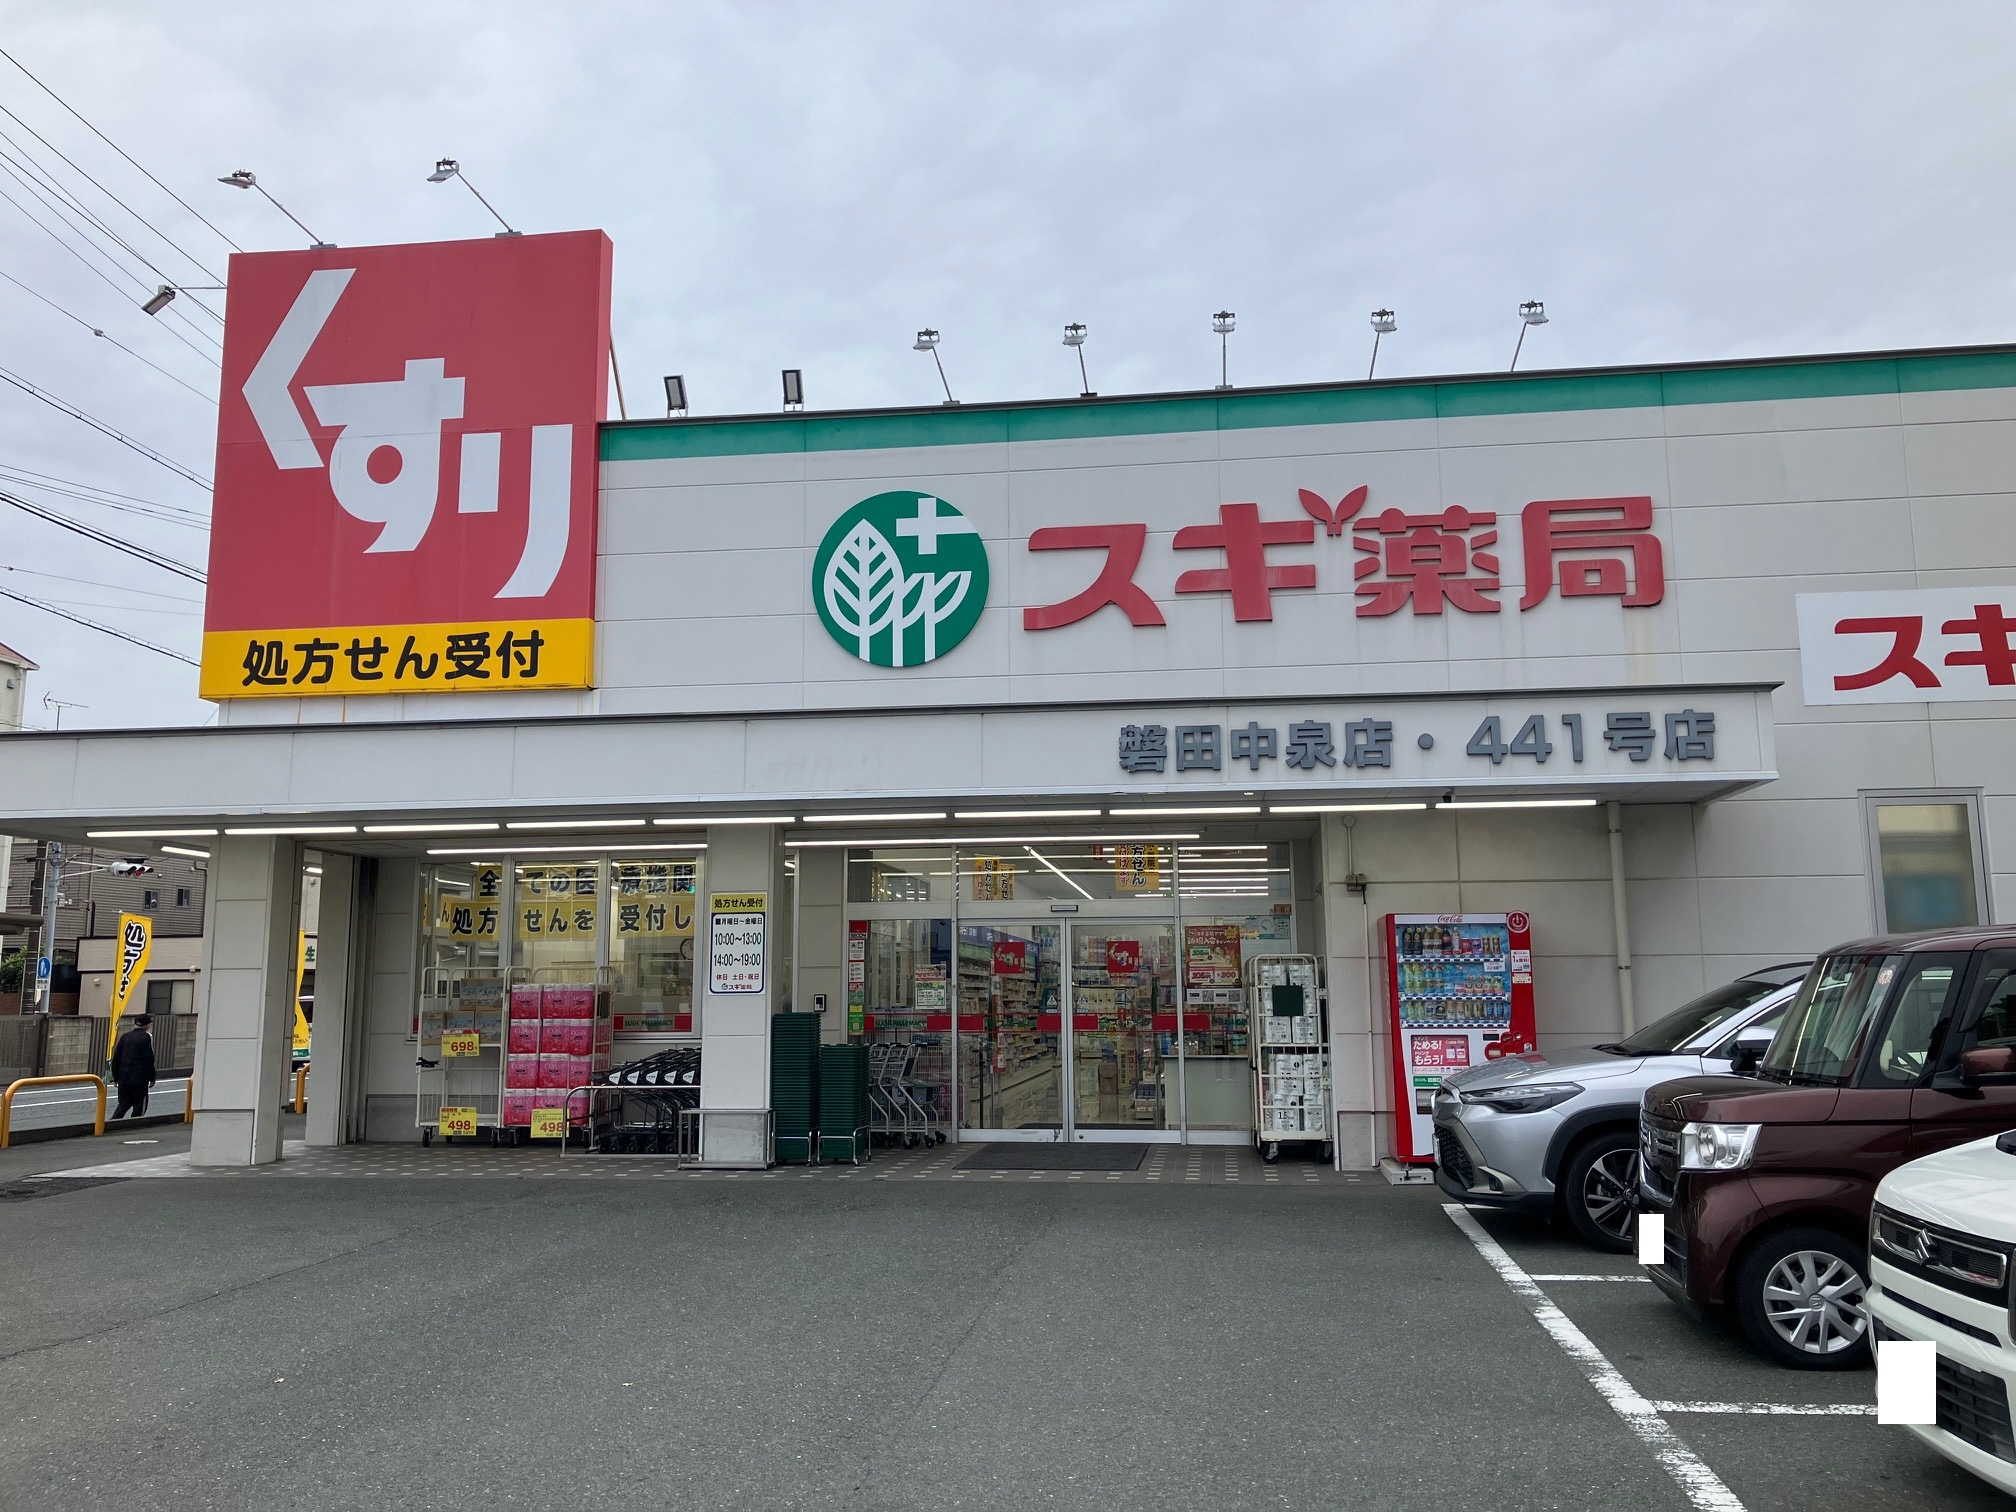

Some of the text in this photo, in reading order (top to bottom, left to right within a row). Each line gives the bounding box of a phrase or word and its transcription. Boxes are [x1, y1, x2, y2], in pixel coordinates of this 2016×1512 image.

[241, 268, 573, 598] くすり
[1023, 485, 1665, 631] スギ薬局
[242, 629, 544, 686] 処方せん受付
[1118, 709, 1716, 773] 磐田中泉店・441号店
[714, 898, 763, 908] 処方せん受付
[716, 973, 728, 981] 休日
